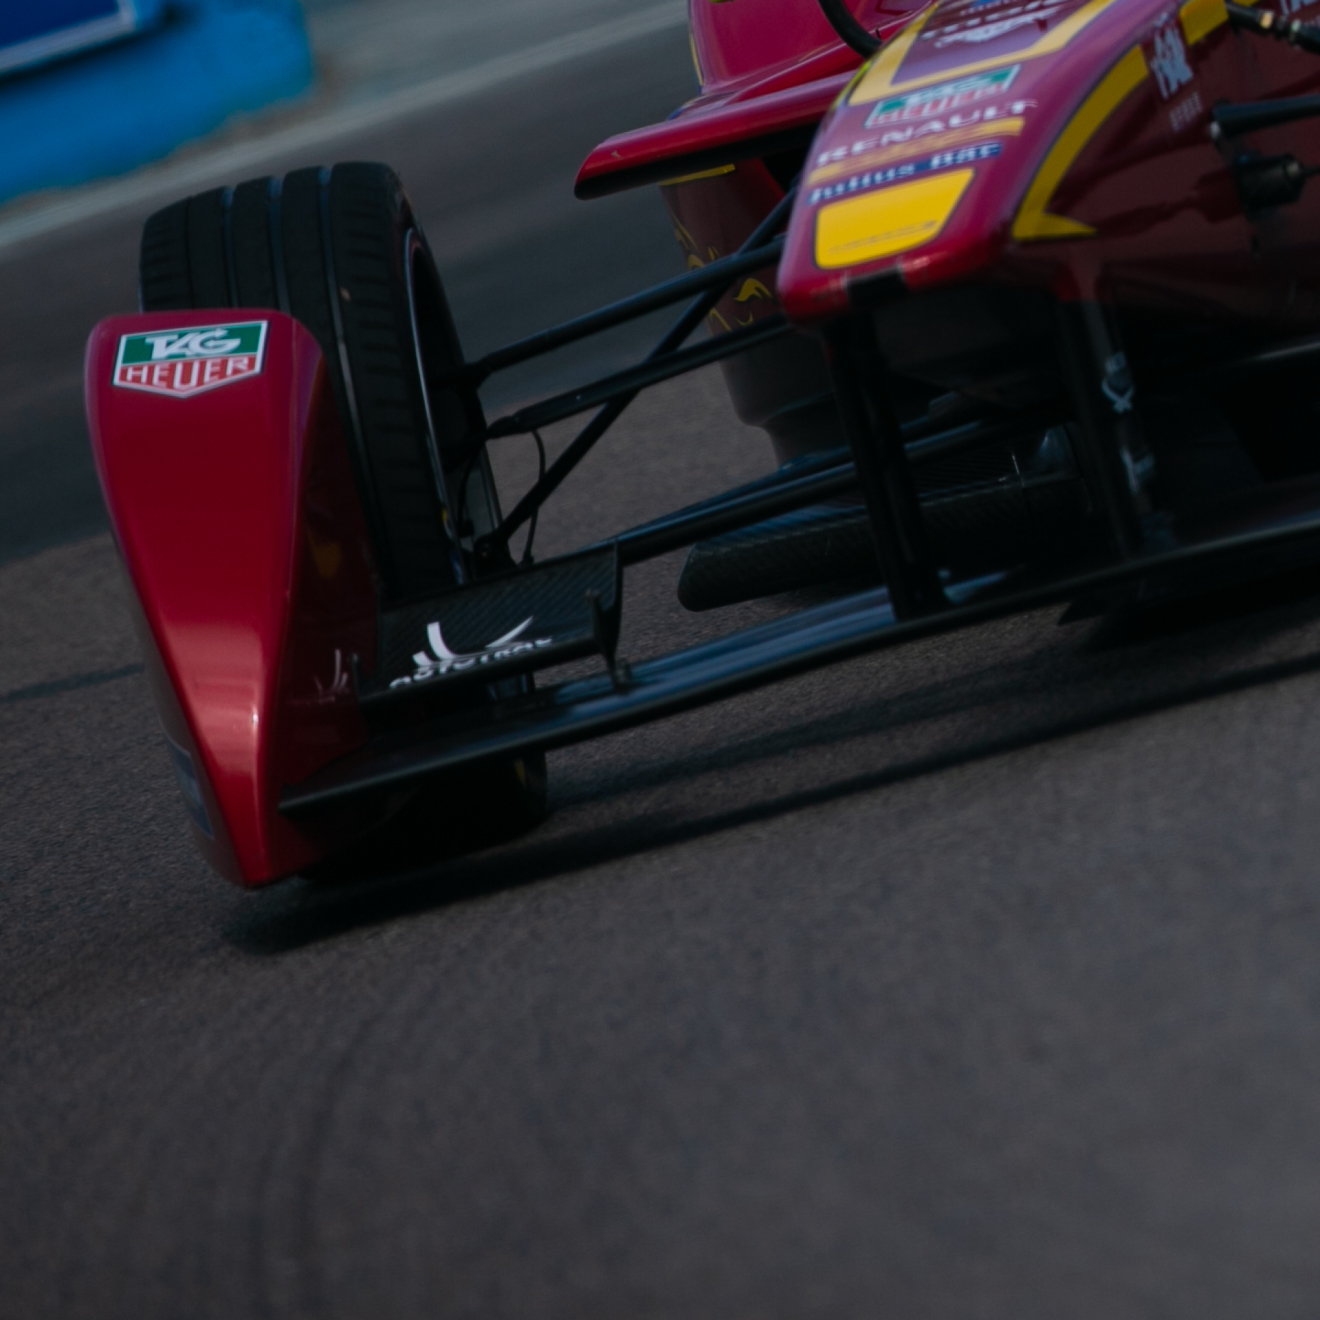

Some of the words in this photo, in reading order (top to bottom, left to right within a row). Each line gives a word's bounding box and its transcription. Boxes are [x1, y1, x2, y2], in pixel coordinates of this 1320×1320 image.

[816, 99, 1039, 166] RENAULT
[811, 164, 915, 204] Julius
[144, 327, 242, 362] TAG
[126, 355, 249, 390] HEUER
